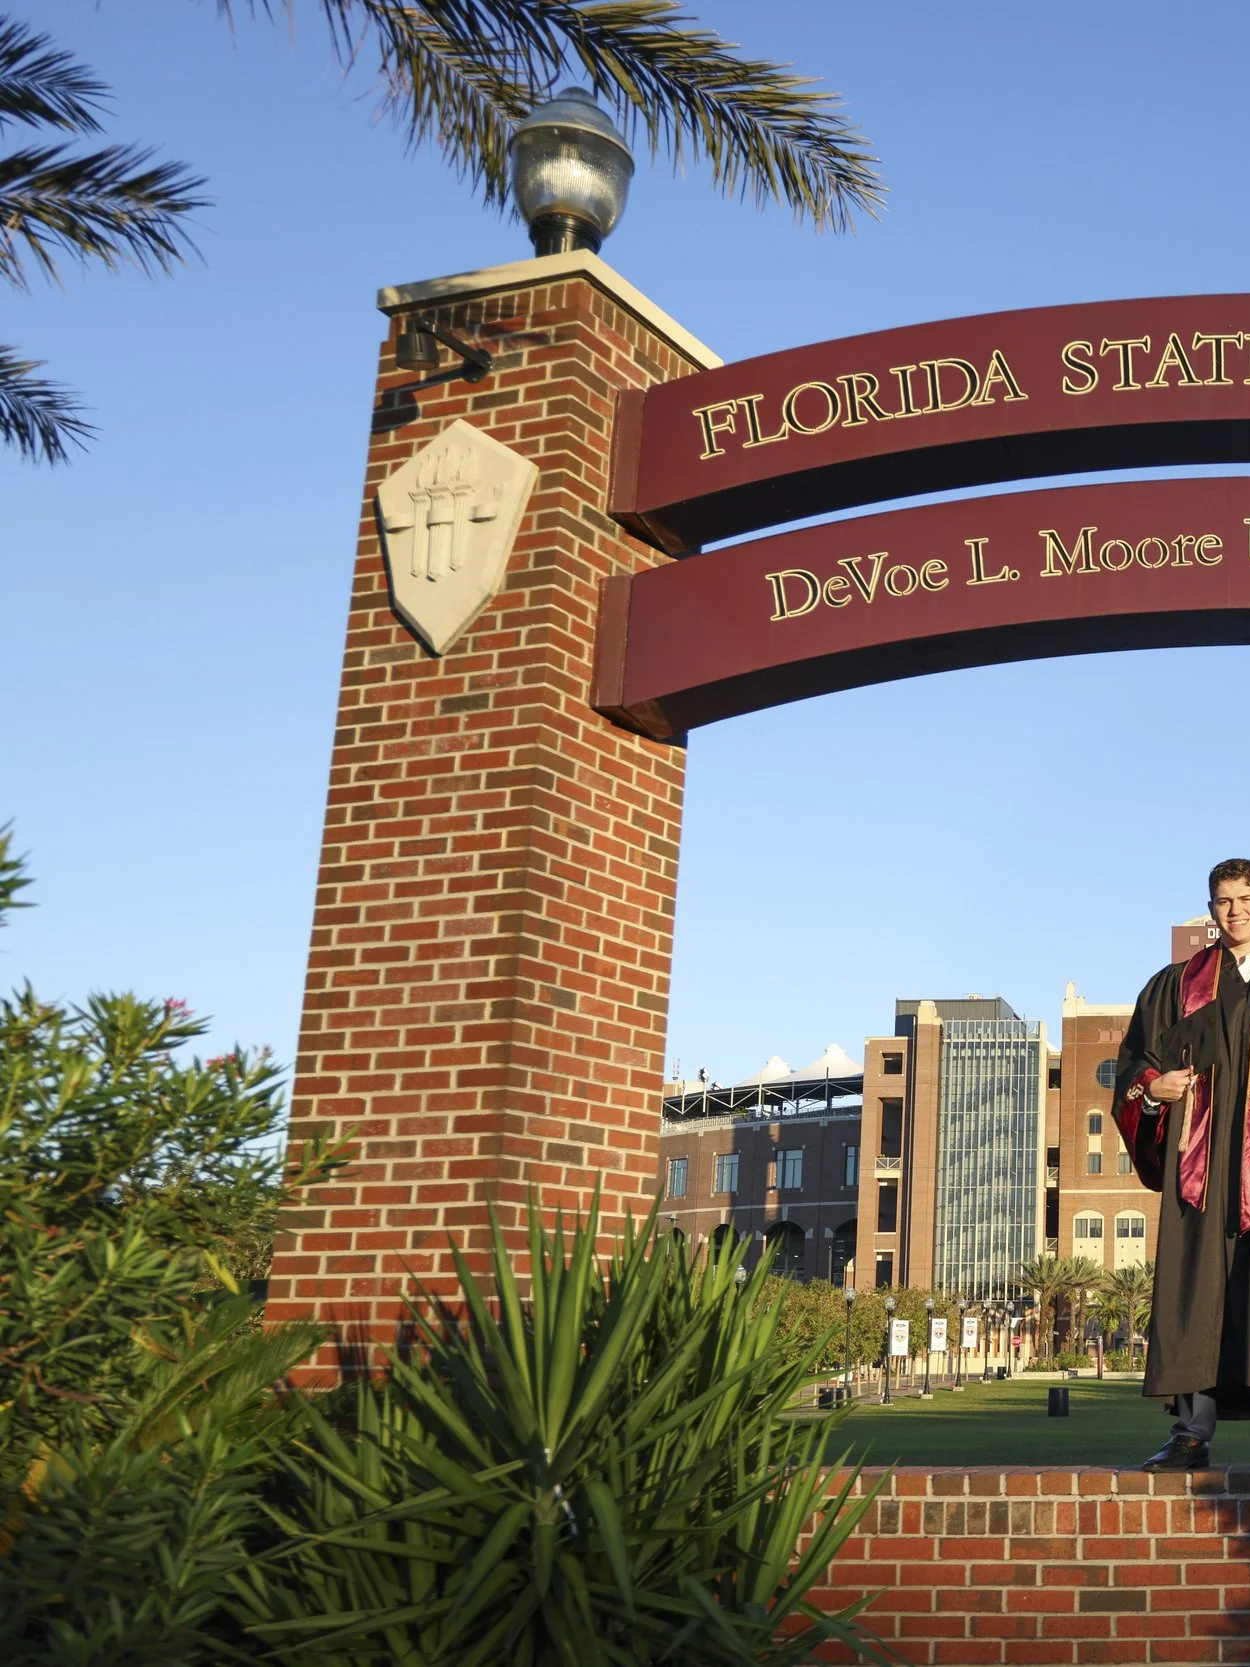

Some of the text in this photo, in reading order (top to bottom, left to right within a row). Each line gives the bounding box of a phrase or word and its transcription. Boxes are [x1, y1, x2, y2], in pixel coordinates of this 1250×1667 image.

[692, 350, 1028, 460] FLORIDA
[766, 551, 950, 621] DeVoe
[965, 537, 1020, 586] L.
[1038, 526, 1223, 578] Moore
[1207, 927, 1221, 939] DO
